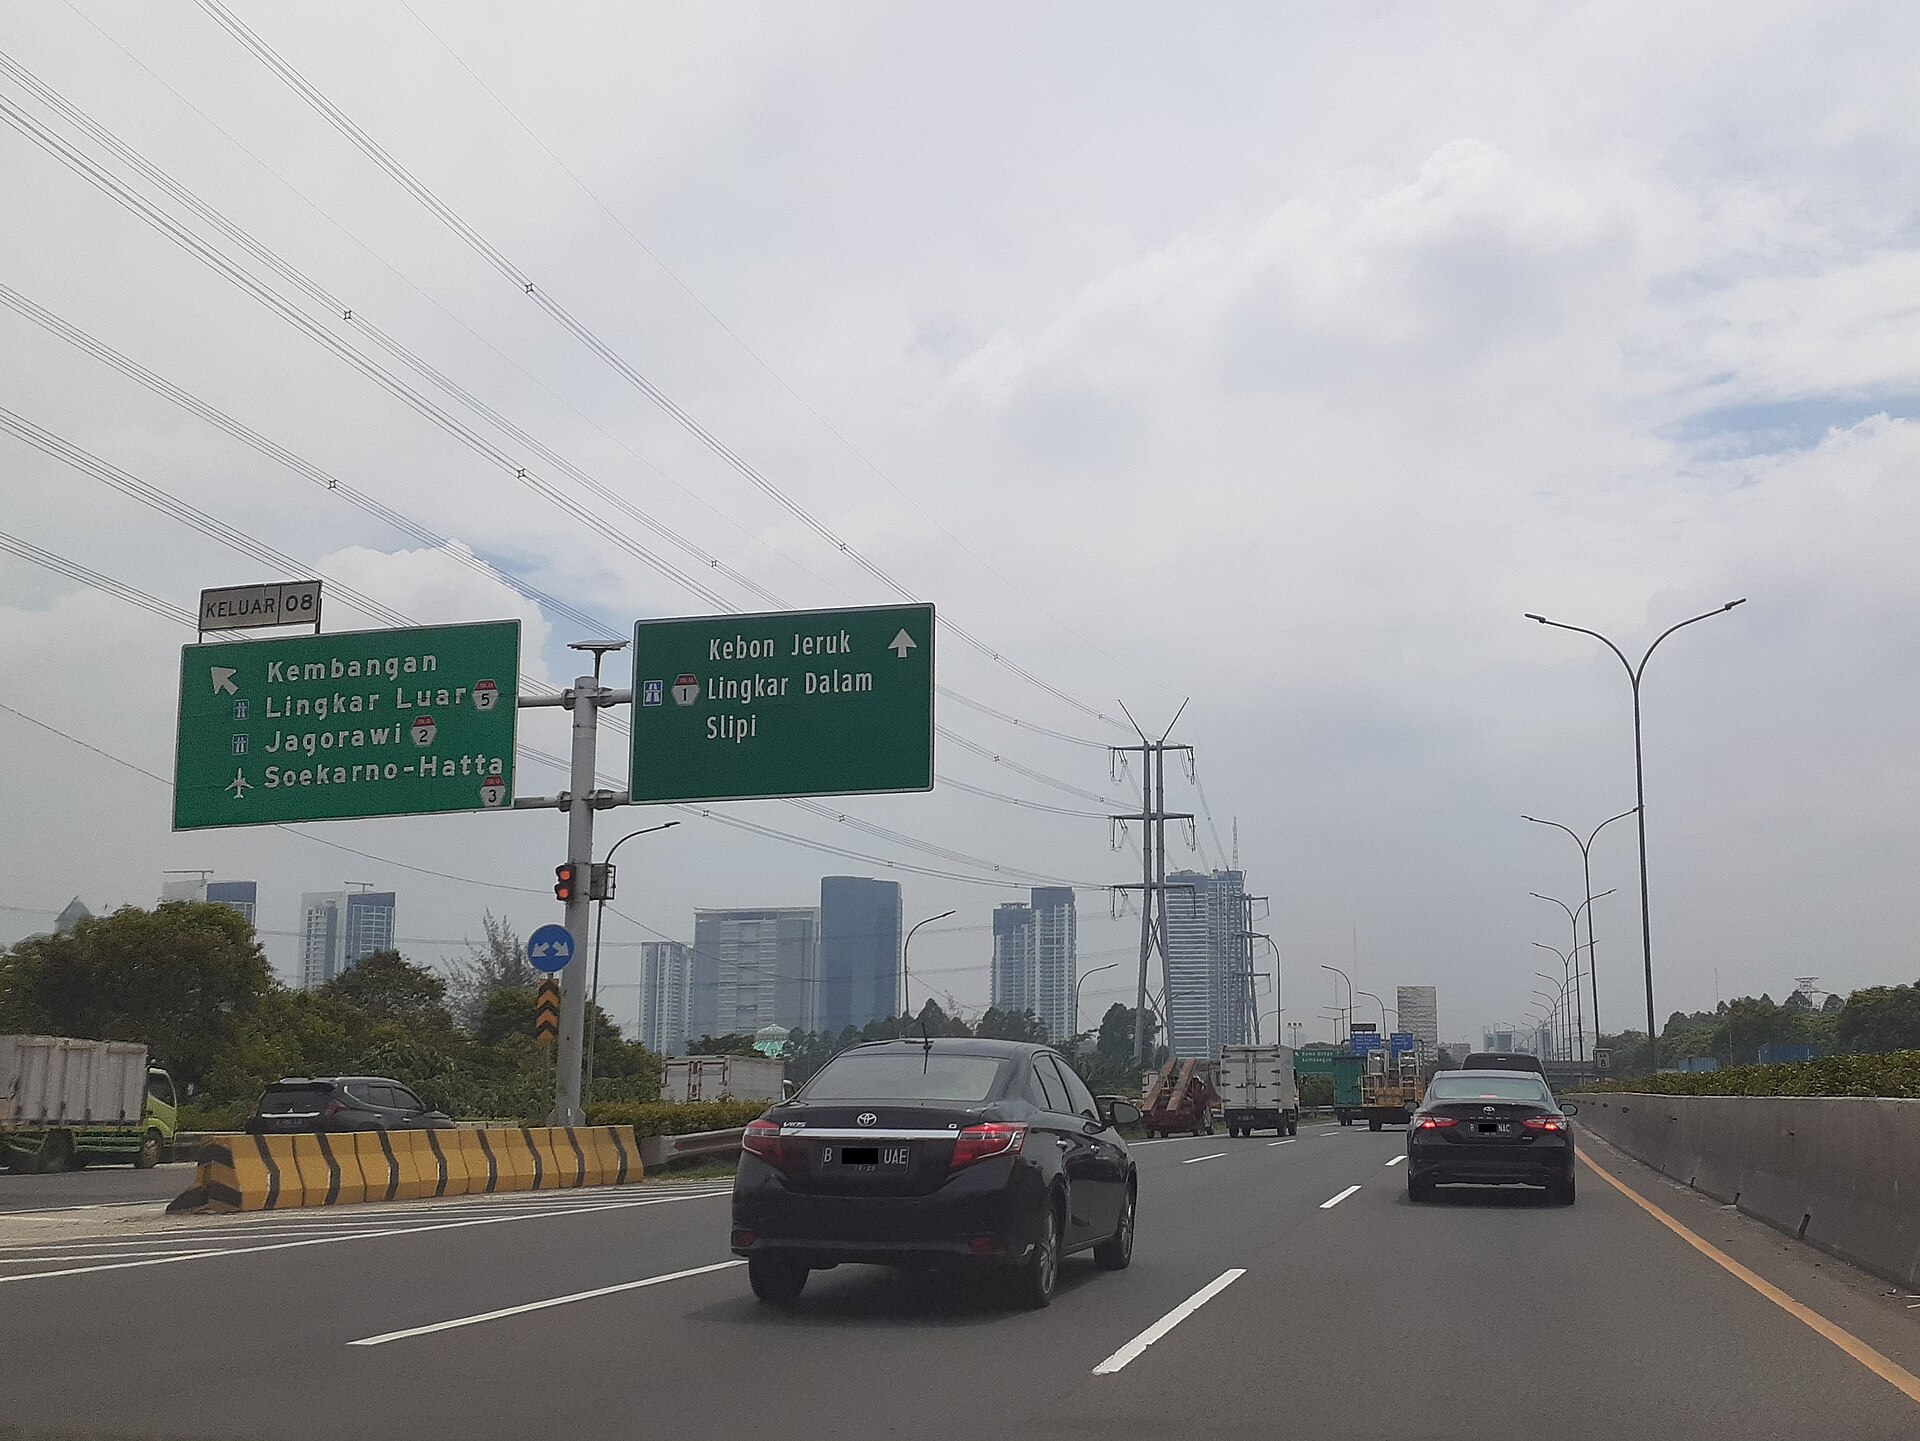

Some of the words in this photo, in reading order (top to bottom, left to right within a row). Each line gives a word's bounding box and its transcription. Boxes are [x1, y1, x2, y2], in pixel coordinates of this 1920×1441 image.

[205, 598, 275, 618] KELUAR
[285, 594, 313, 612] 08
[709, 635, 774, 661] Kebon
[791, 630, 851, 656] Jeruk
[267, 653, 437, 683] Kembangan
[481, 693, 490, 706] 5
[683, 688, 687, 701] 1
[708, 673, 789, 704] Lingkar
[805, 669, 873, 695] Dalam
[266, 692, 379, 720] Lingkar
[396, 687, 467, 709] Luar
[265, 722, 402, 757] Jagorawi
[419, 729, 428, 742] 2
[706, 714, 756, 743] Slipi
[264, 754, 503, 788] Soekarno-Hatta
[488, 789, 497, 802] 3
[823, 1147, 833, 1163] B
[883, 1148, 908, 1165] UAE
